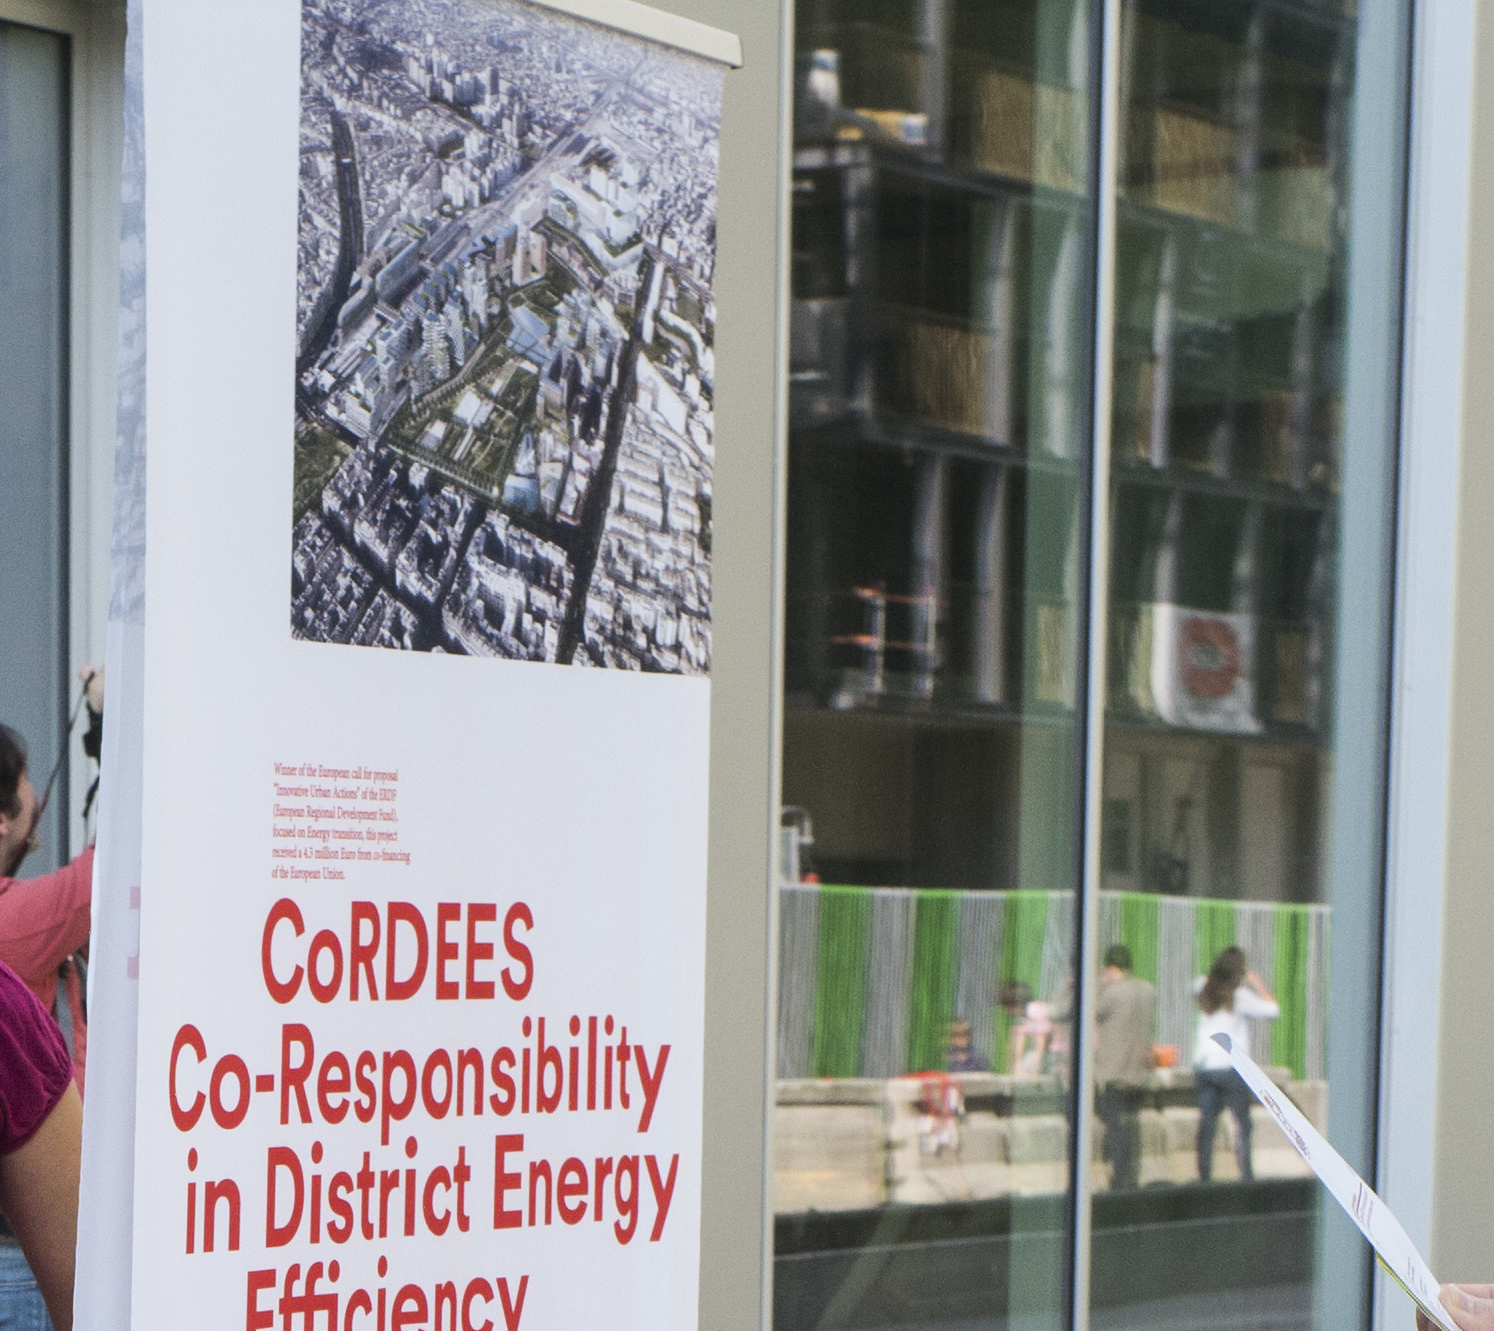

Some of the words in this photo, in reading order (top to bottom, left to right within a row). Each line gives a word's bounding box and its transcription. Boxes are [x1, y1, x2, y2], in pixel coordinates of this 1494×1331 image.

[262, 898, 533, 1004] CoRDEES
[170, 1016, 670, 1145] Co-Responsibility
[187, 1148, 240, 1254] in
[266, 1137, 470, 1248] District
[494, 1134, 678, 1244] Energy
